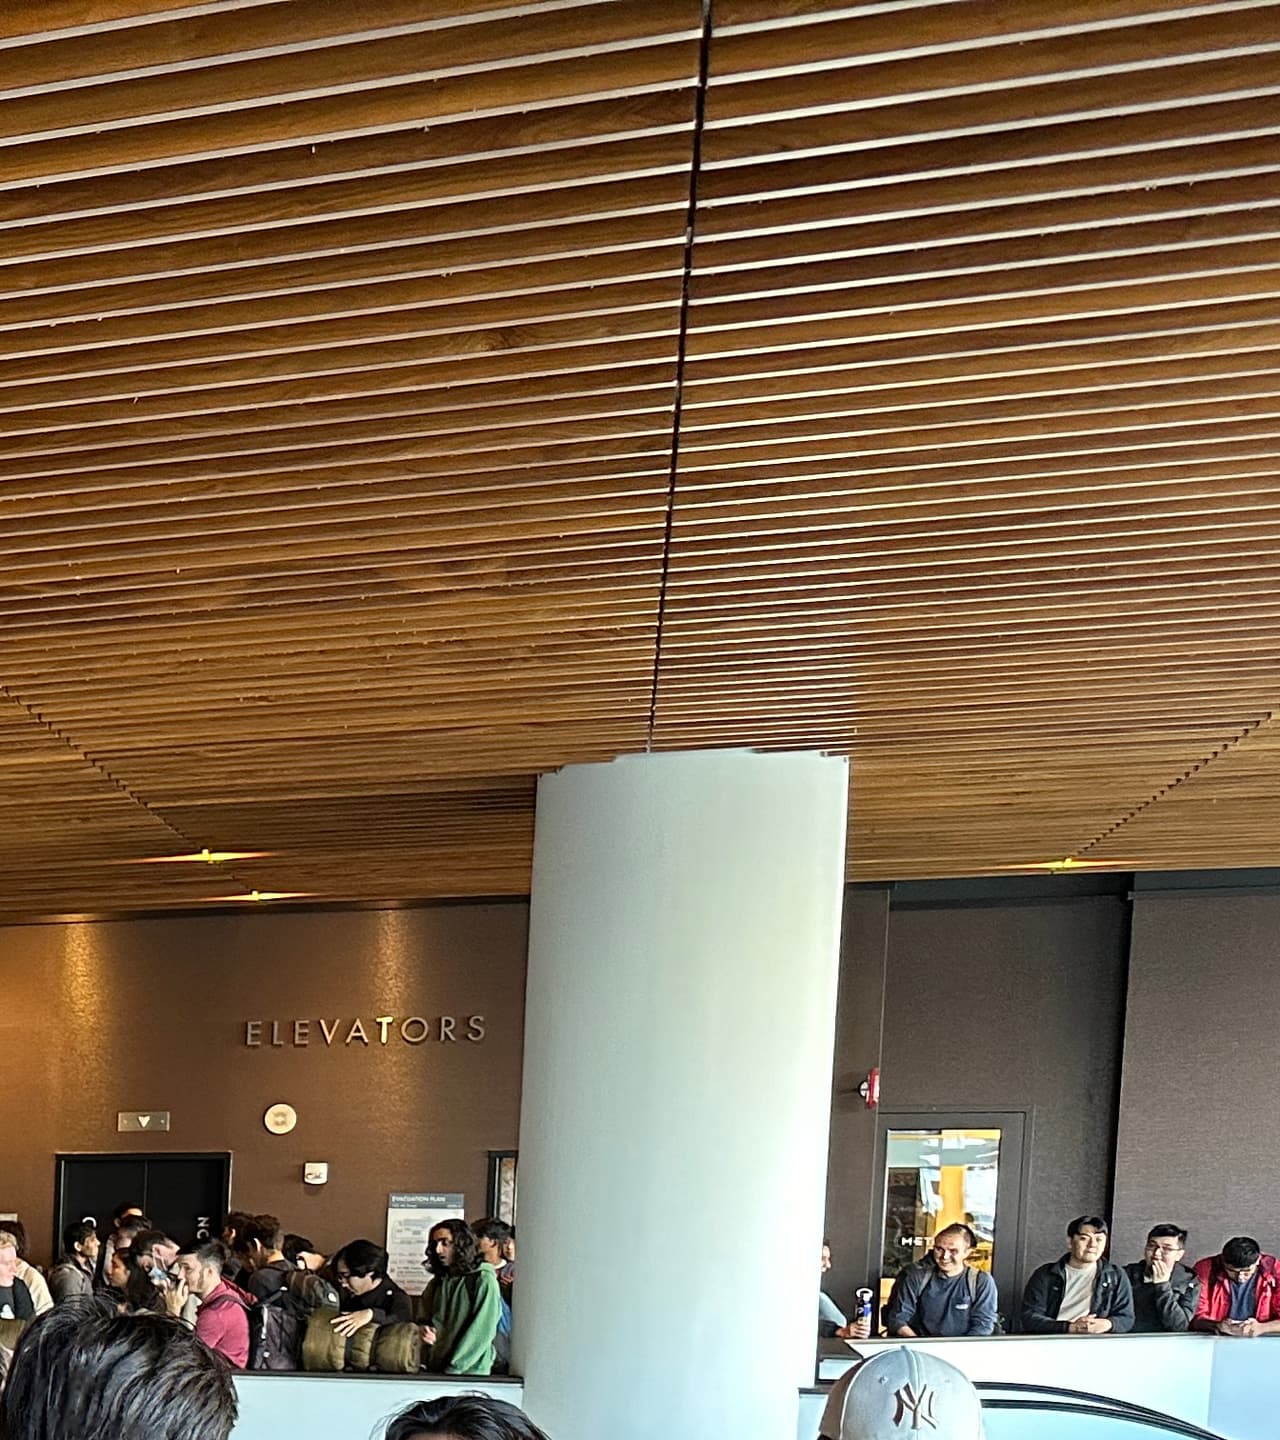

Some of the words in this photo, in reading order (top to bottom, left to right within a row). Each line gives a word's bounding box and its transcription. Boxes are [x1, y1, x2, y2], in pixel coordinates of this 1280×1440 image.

[245, 1015, 486, 1047] ELEVATORS
[901, 1236, 936, 1246] MET
[893, 1382, 938, 1431] NY
